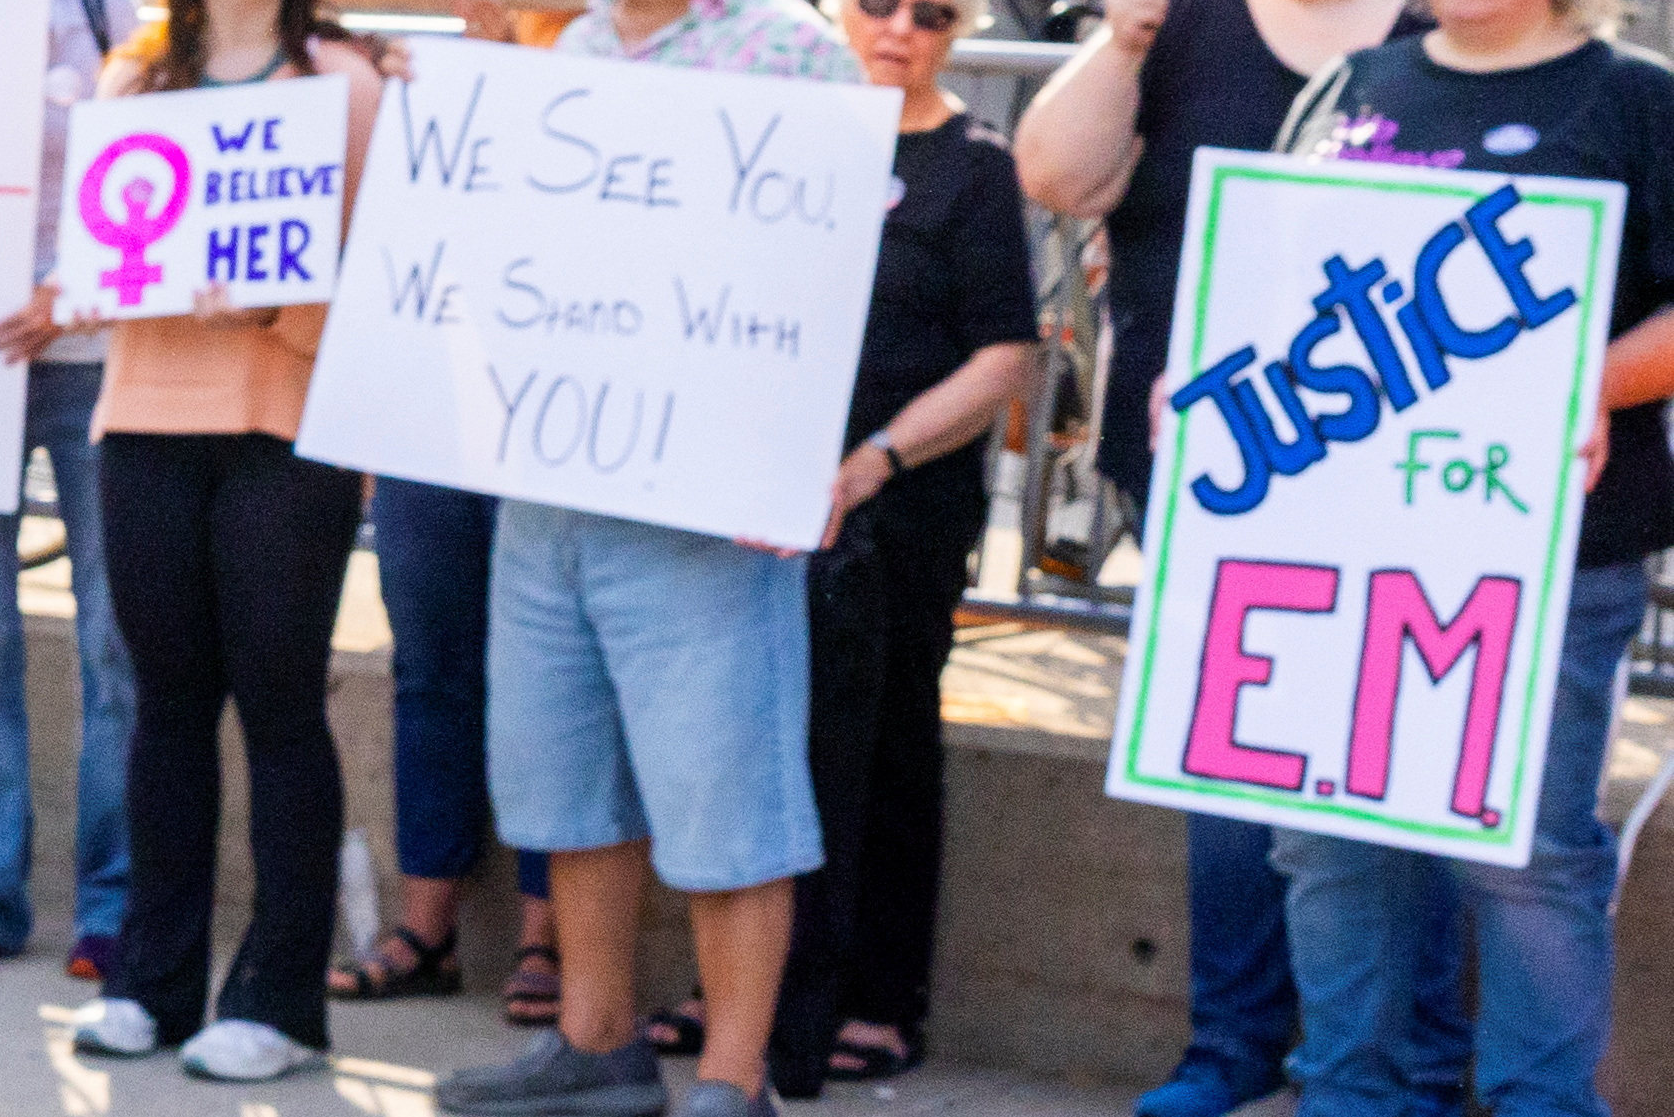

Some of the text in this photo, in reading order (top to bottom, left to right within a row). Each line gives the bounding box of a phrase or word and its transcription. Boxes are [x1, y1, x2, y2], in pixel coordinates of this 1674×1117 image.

[211, 116, 283, 154] WE
[205, 163, 340, 206] BELIEVE
[206, 218, 313, 282] HER
[484, 361, 677, 493] YOU!
[1182, 557, 1522, 828] E.M.
